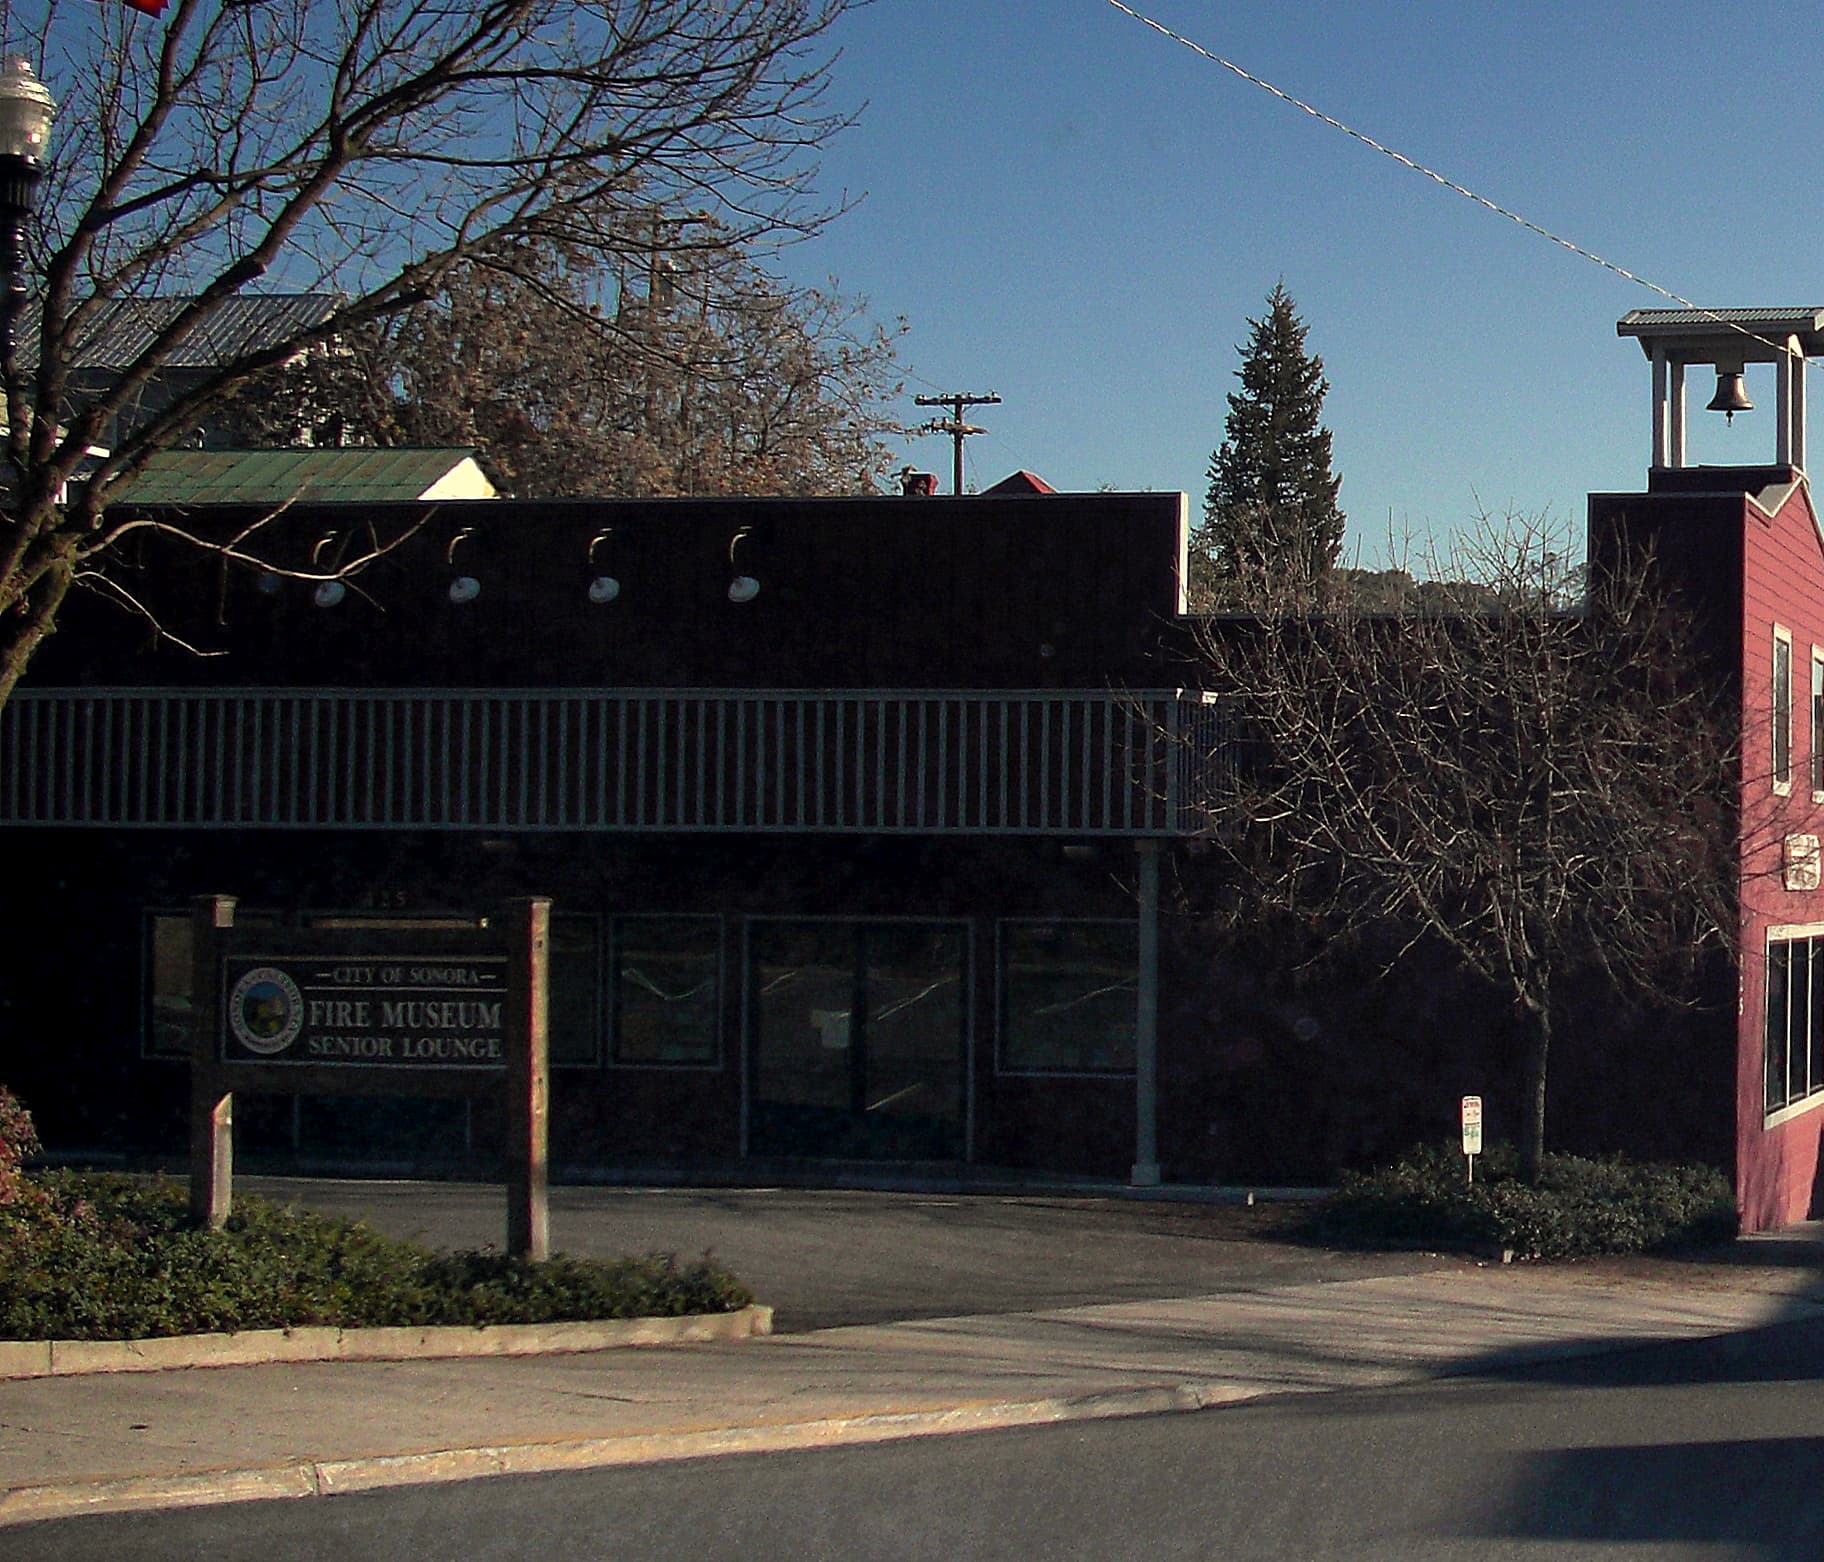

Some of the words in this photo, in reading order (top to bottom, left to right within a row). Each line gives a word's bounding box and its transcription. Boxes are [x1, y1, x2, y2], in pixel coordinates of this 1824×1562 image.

[333, 967, 376, 984] CITY
[382, 968, 401, 984] OF
[410, 968, 479, 985] SONORA
[309, 1001, 370, 1027] FIRE
[381, 1001, 502, 1028] MUSEUM
[308, 1037, 393, 1057] SENIOR
[402, 1038, 502, 1058] LOUNGE
